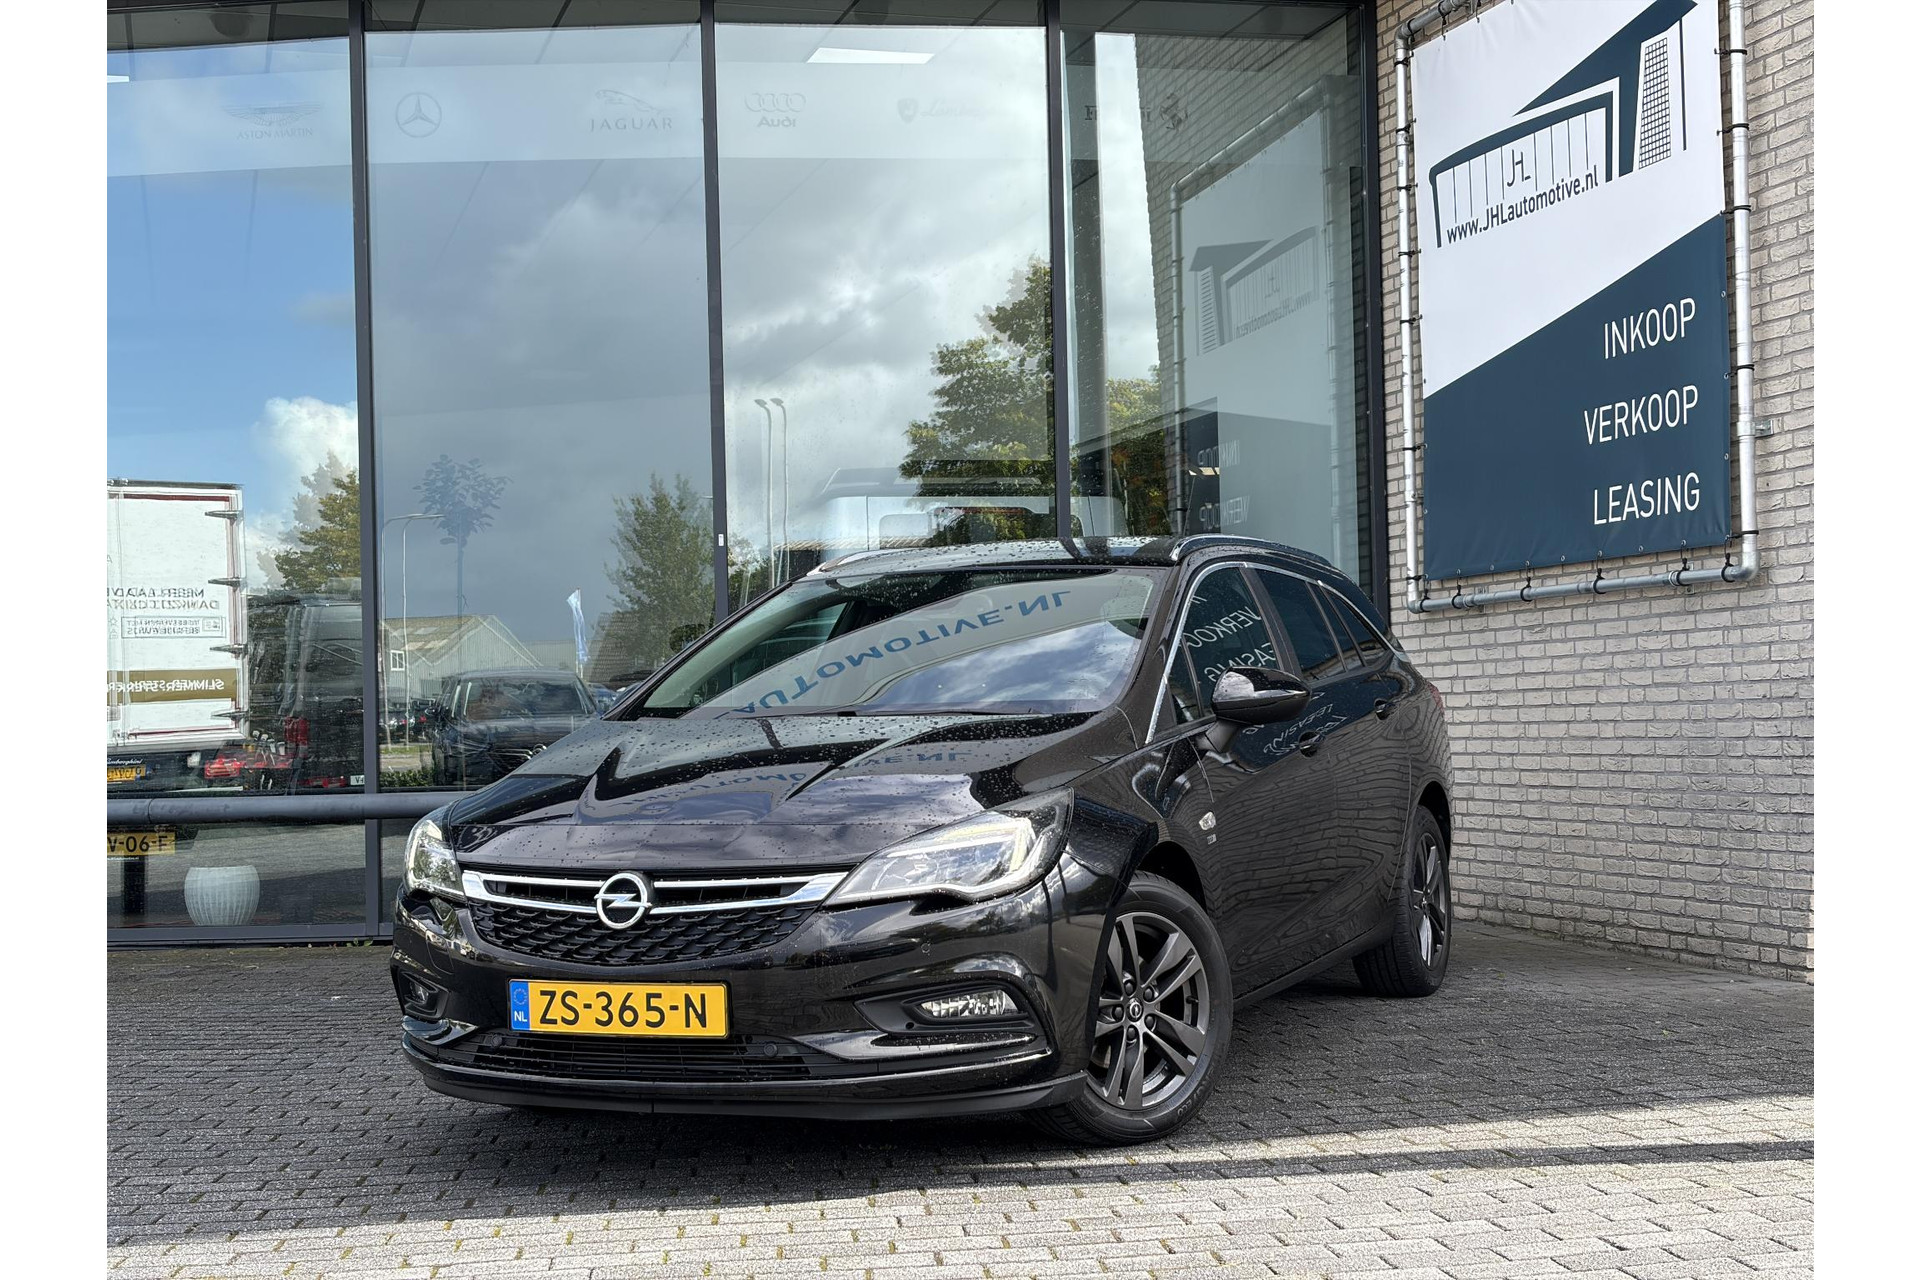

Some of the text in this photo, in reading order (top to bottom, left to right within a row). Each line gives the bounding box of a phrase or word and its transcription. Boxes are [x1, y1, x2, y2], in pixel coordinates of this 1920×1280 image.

[590, 116, 674, 132] JAGUAR
[757, 116, 797, 128] Audi
[1446, 165, 1599, 245] www.JHLautomotive.nl
[1604, 297, 1696, 360] INKOOP
[1583, 384, 1699, 446] VERKOOP
[1593, 471, 1700, 526] LEASING
[514, 1011, 528, 1022] NL
[539, 989, 707, 1029] ZS-365-N
